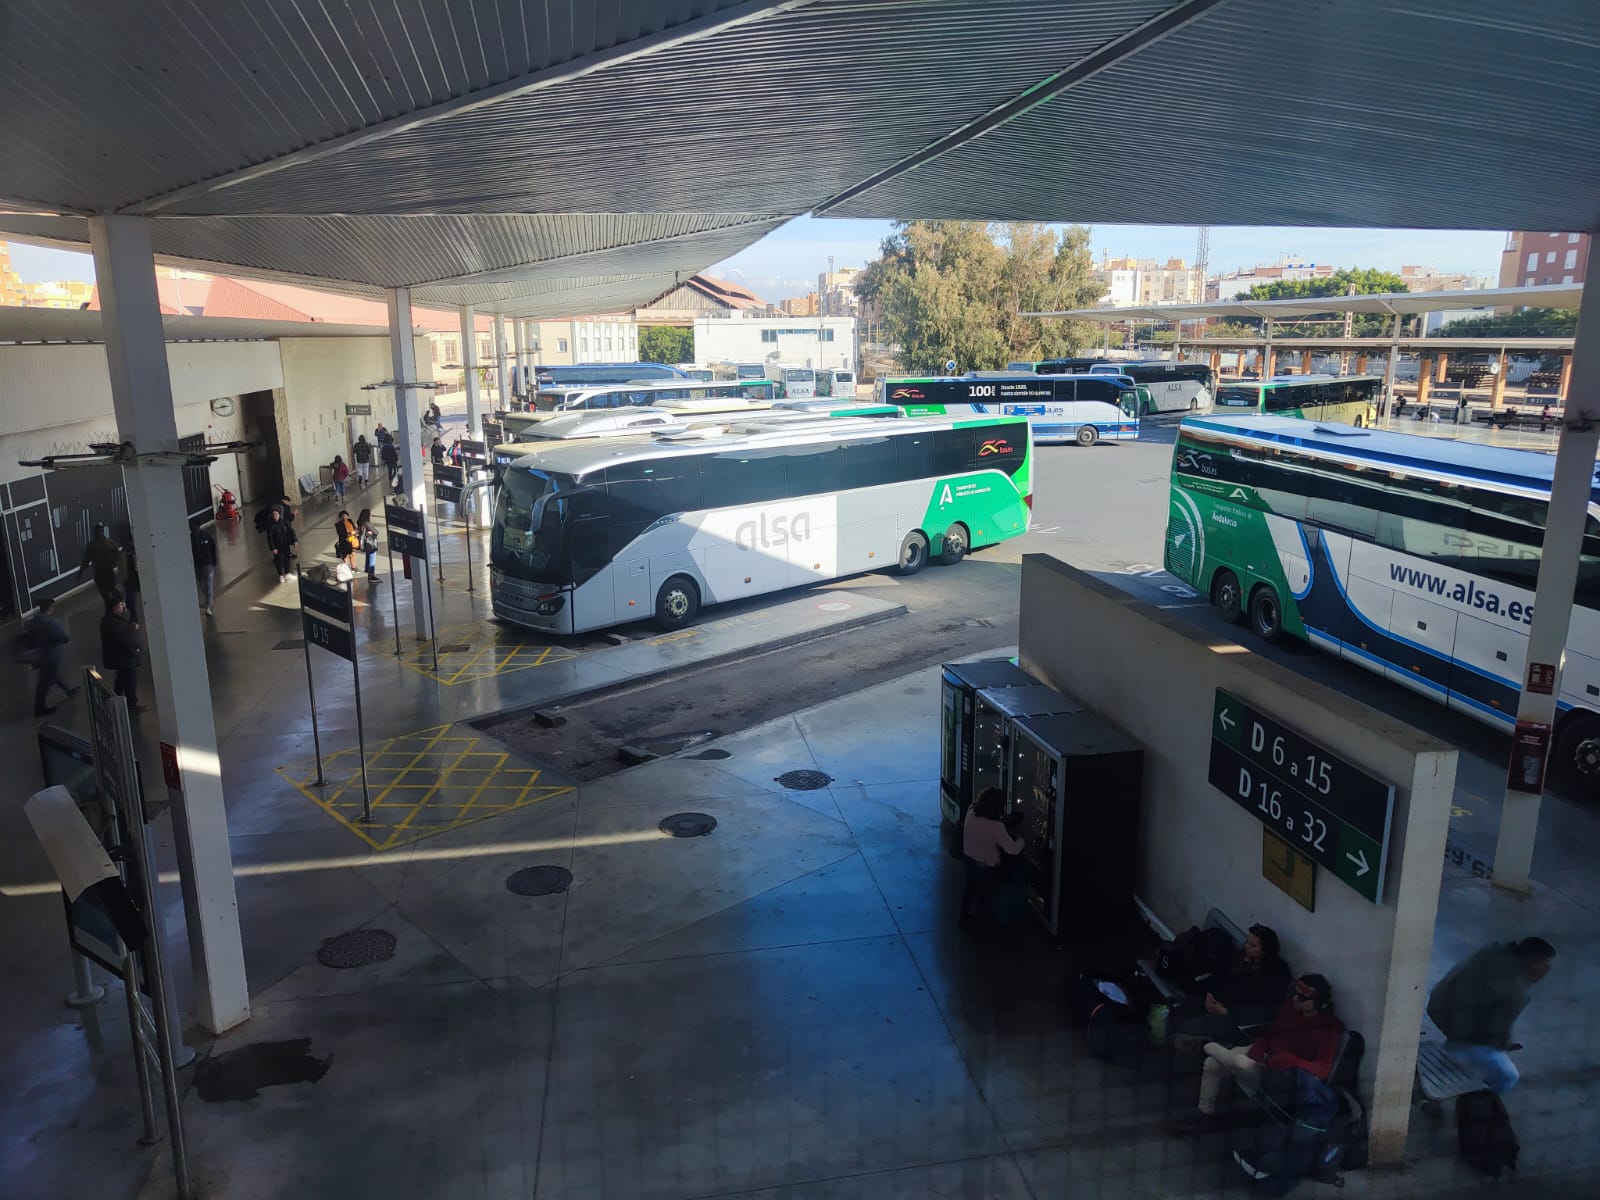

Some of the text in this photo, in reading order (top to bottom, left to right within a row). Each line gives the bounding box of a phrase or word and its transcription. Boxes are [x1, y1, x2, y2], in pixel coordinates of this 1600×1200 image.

[968, 385, 991, 397] 100
[735, 511, 810, 552] alsa
[1390, 562, 1534, 626] www.alsa.es
[320, 627, 329, 644] 15
[1251, 721, 1332, 795] D 6 a 15
[1238, 767, 1327, 853] D 16 a 32
